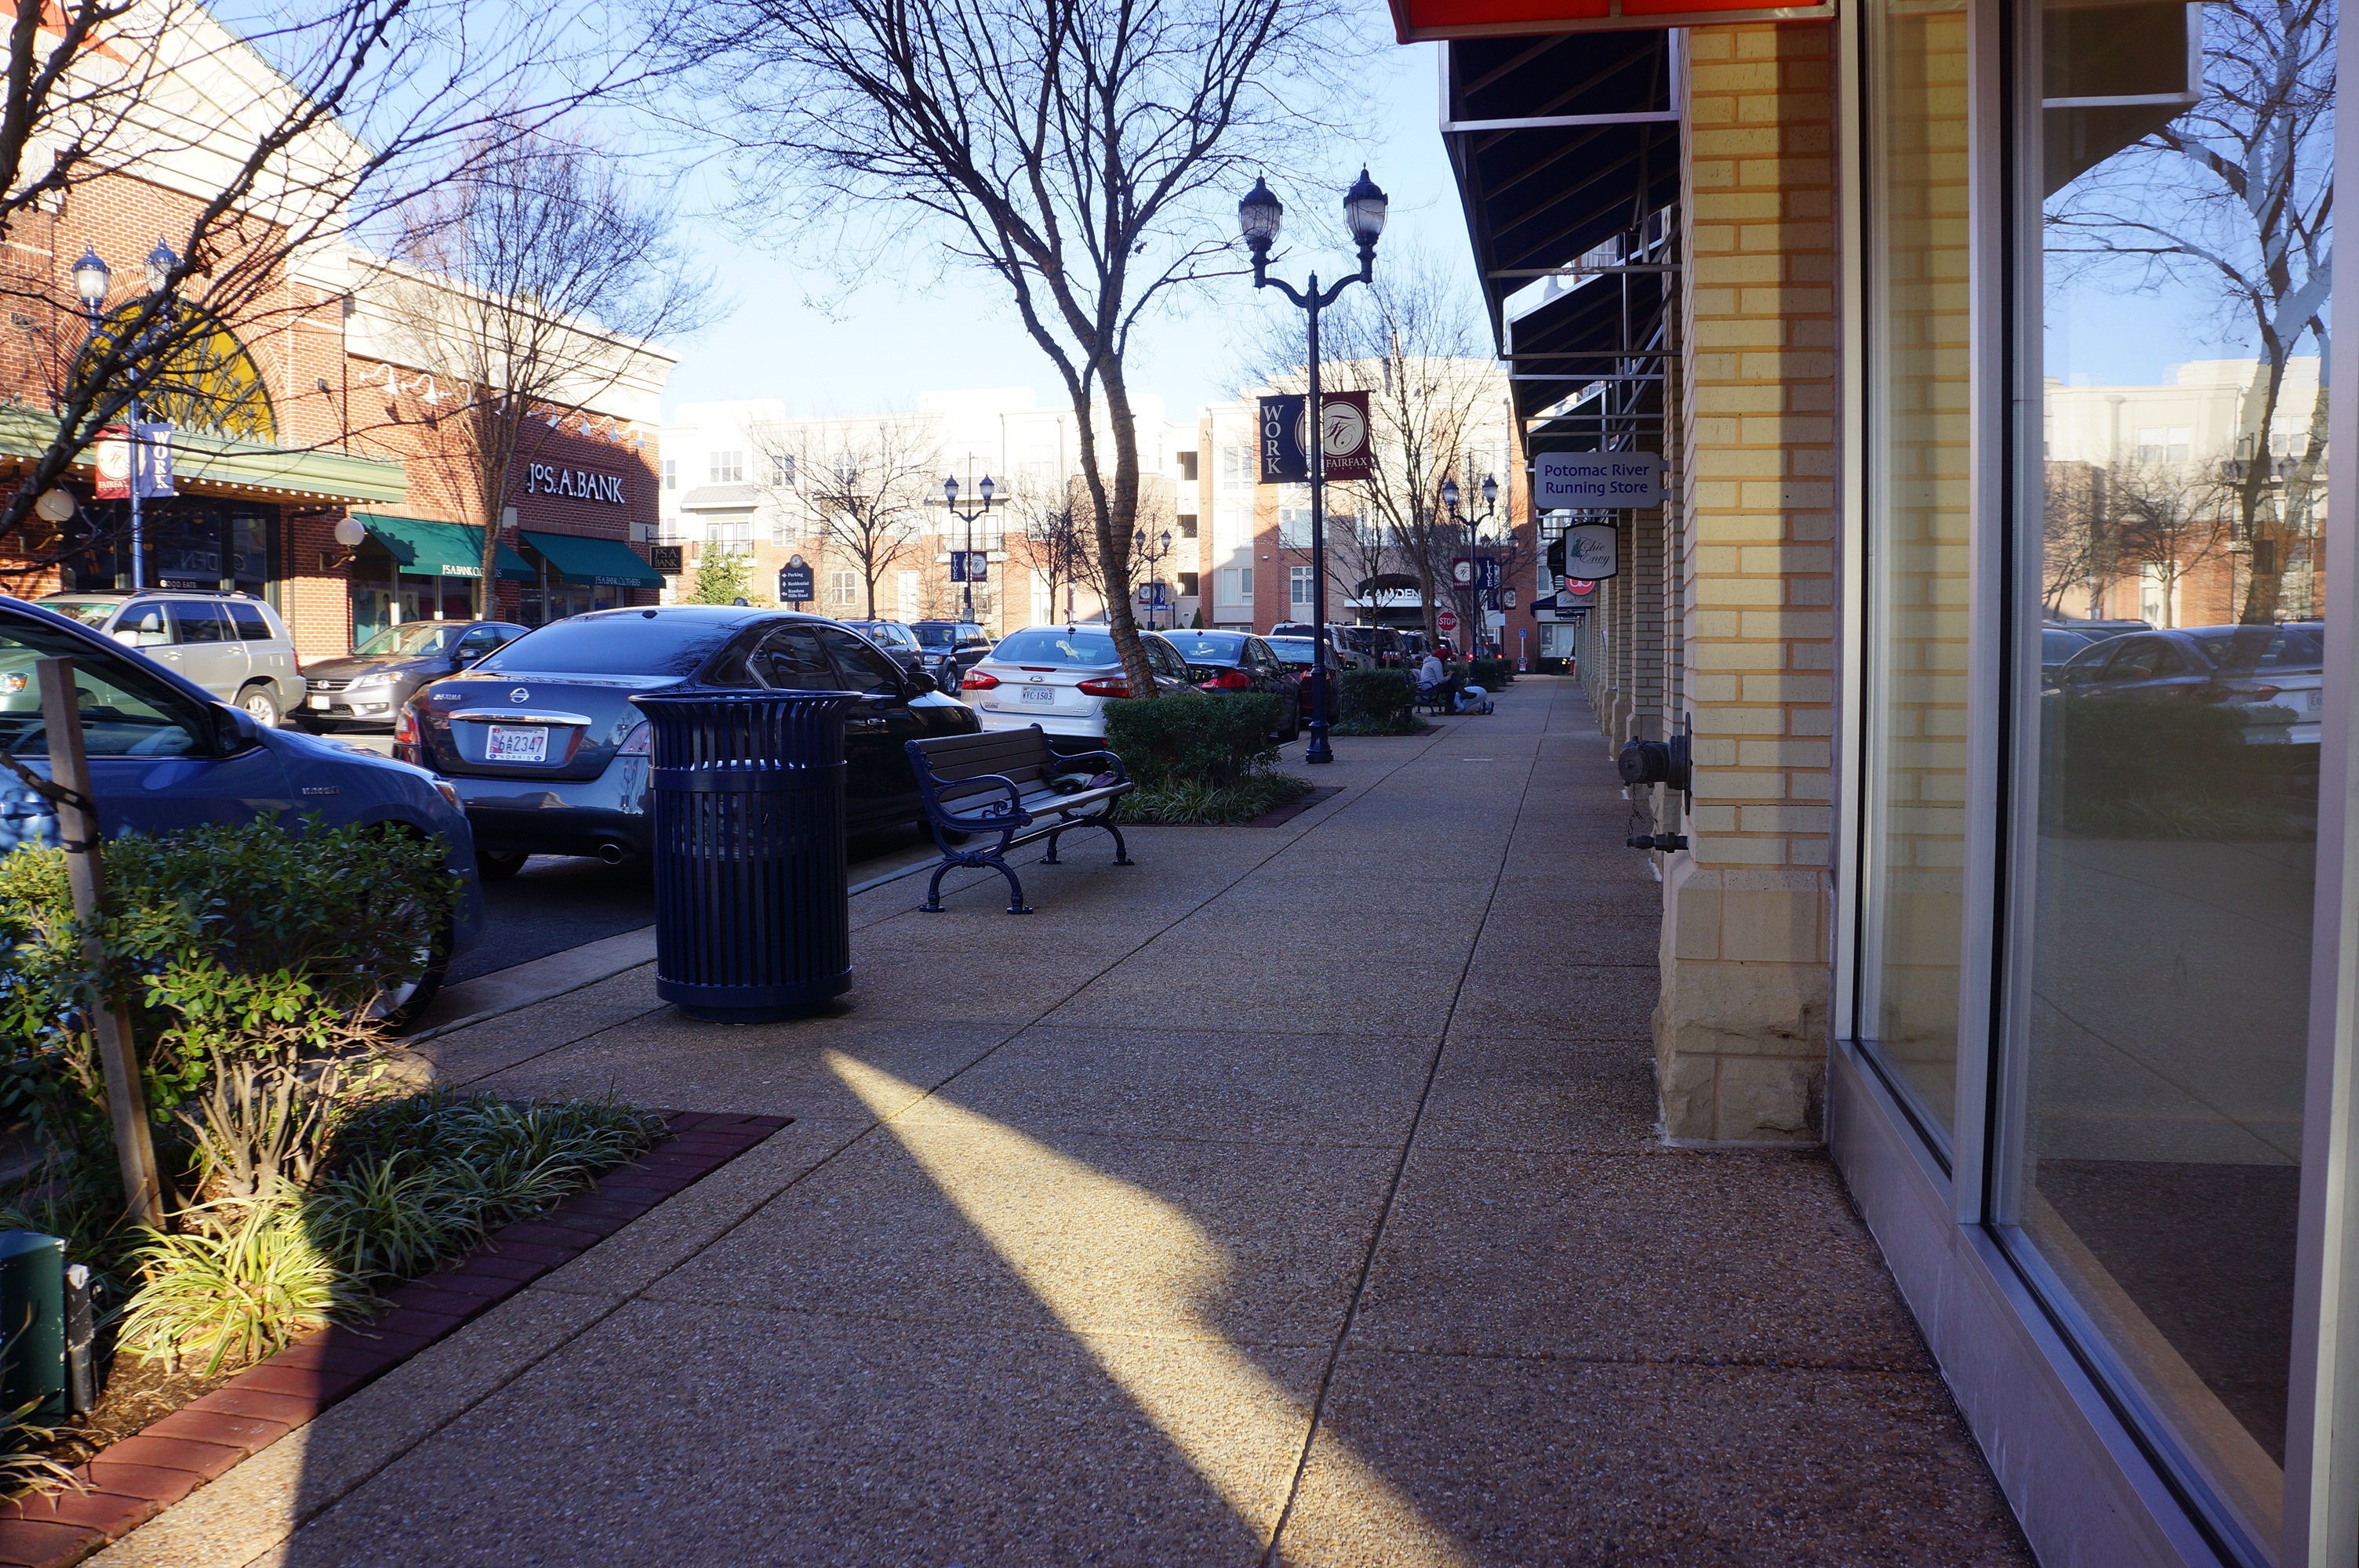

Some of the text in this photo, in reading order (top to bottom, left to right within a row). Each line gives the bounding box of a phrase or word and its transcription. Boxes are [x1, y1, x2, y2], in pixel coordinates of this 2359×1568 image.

[1262, 405, 1285, 474] WORK
[151, 431, 171, 489] WORK
[1326, 458, 1368, 467] FAIRFAX
[1545, 464, 1649, 477] Potomac River
[1546, 481, 1648, 496] Running Store
[1579, 552, 1610, 568] Envy
[1364, 588, 1422, 600] CAMDEN
[1438, 618, 1456, 626] STOP
